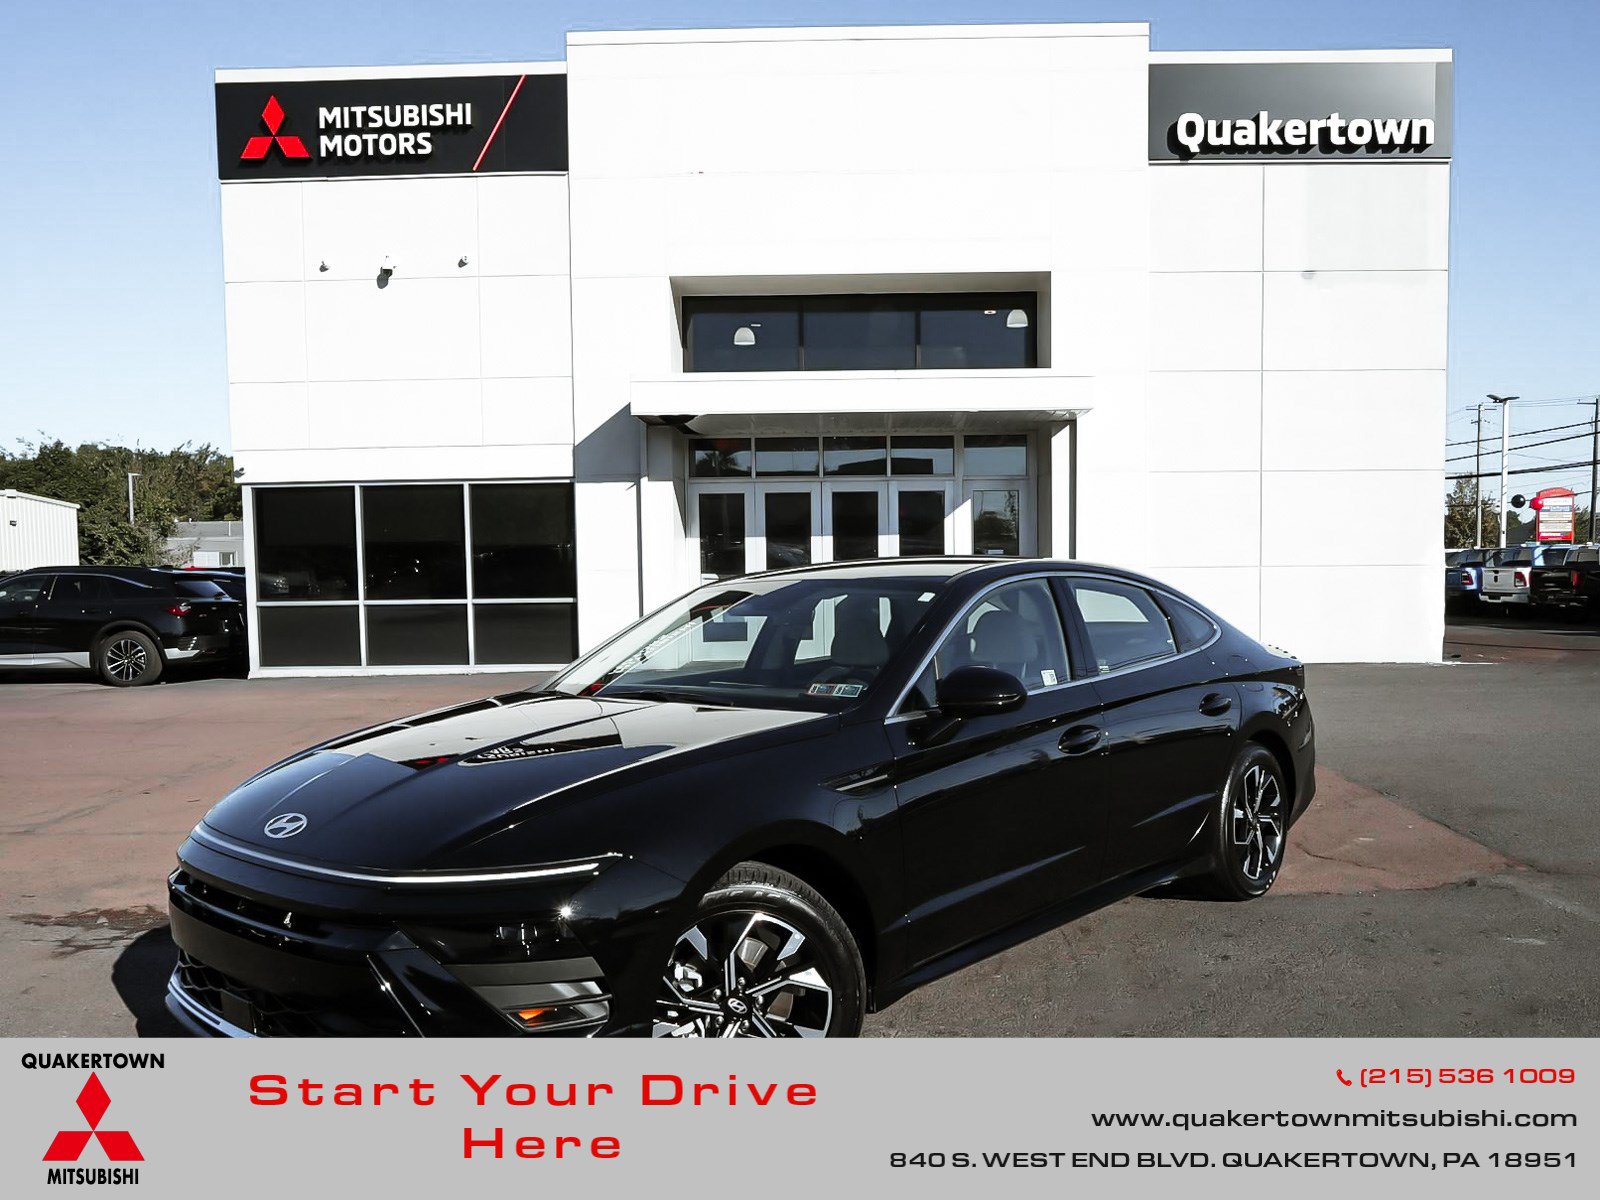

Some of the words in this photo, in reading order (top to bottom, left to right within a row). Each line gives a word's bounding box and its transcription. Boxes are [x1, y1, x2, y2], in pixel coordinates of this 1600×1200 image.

[318, 102, 472, 129] MITSUBISHI
[319, 132, 432, 158] MOTORS
[1176, 111, 1435, 153] Quakertown
